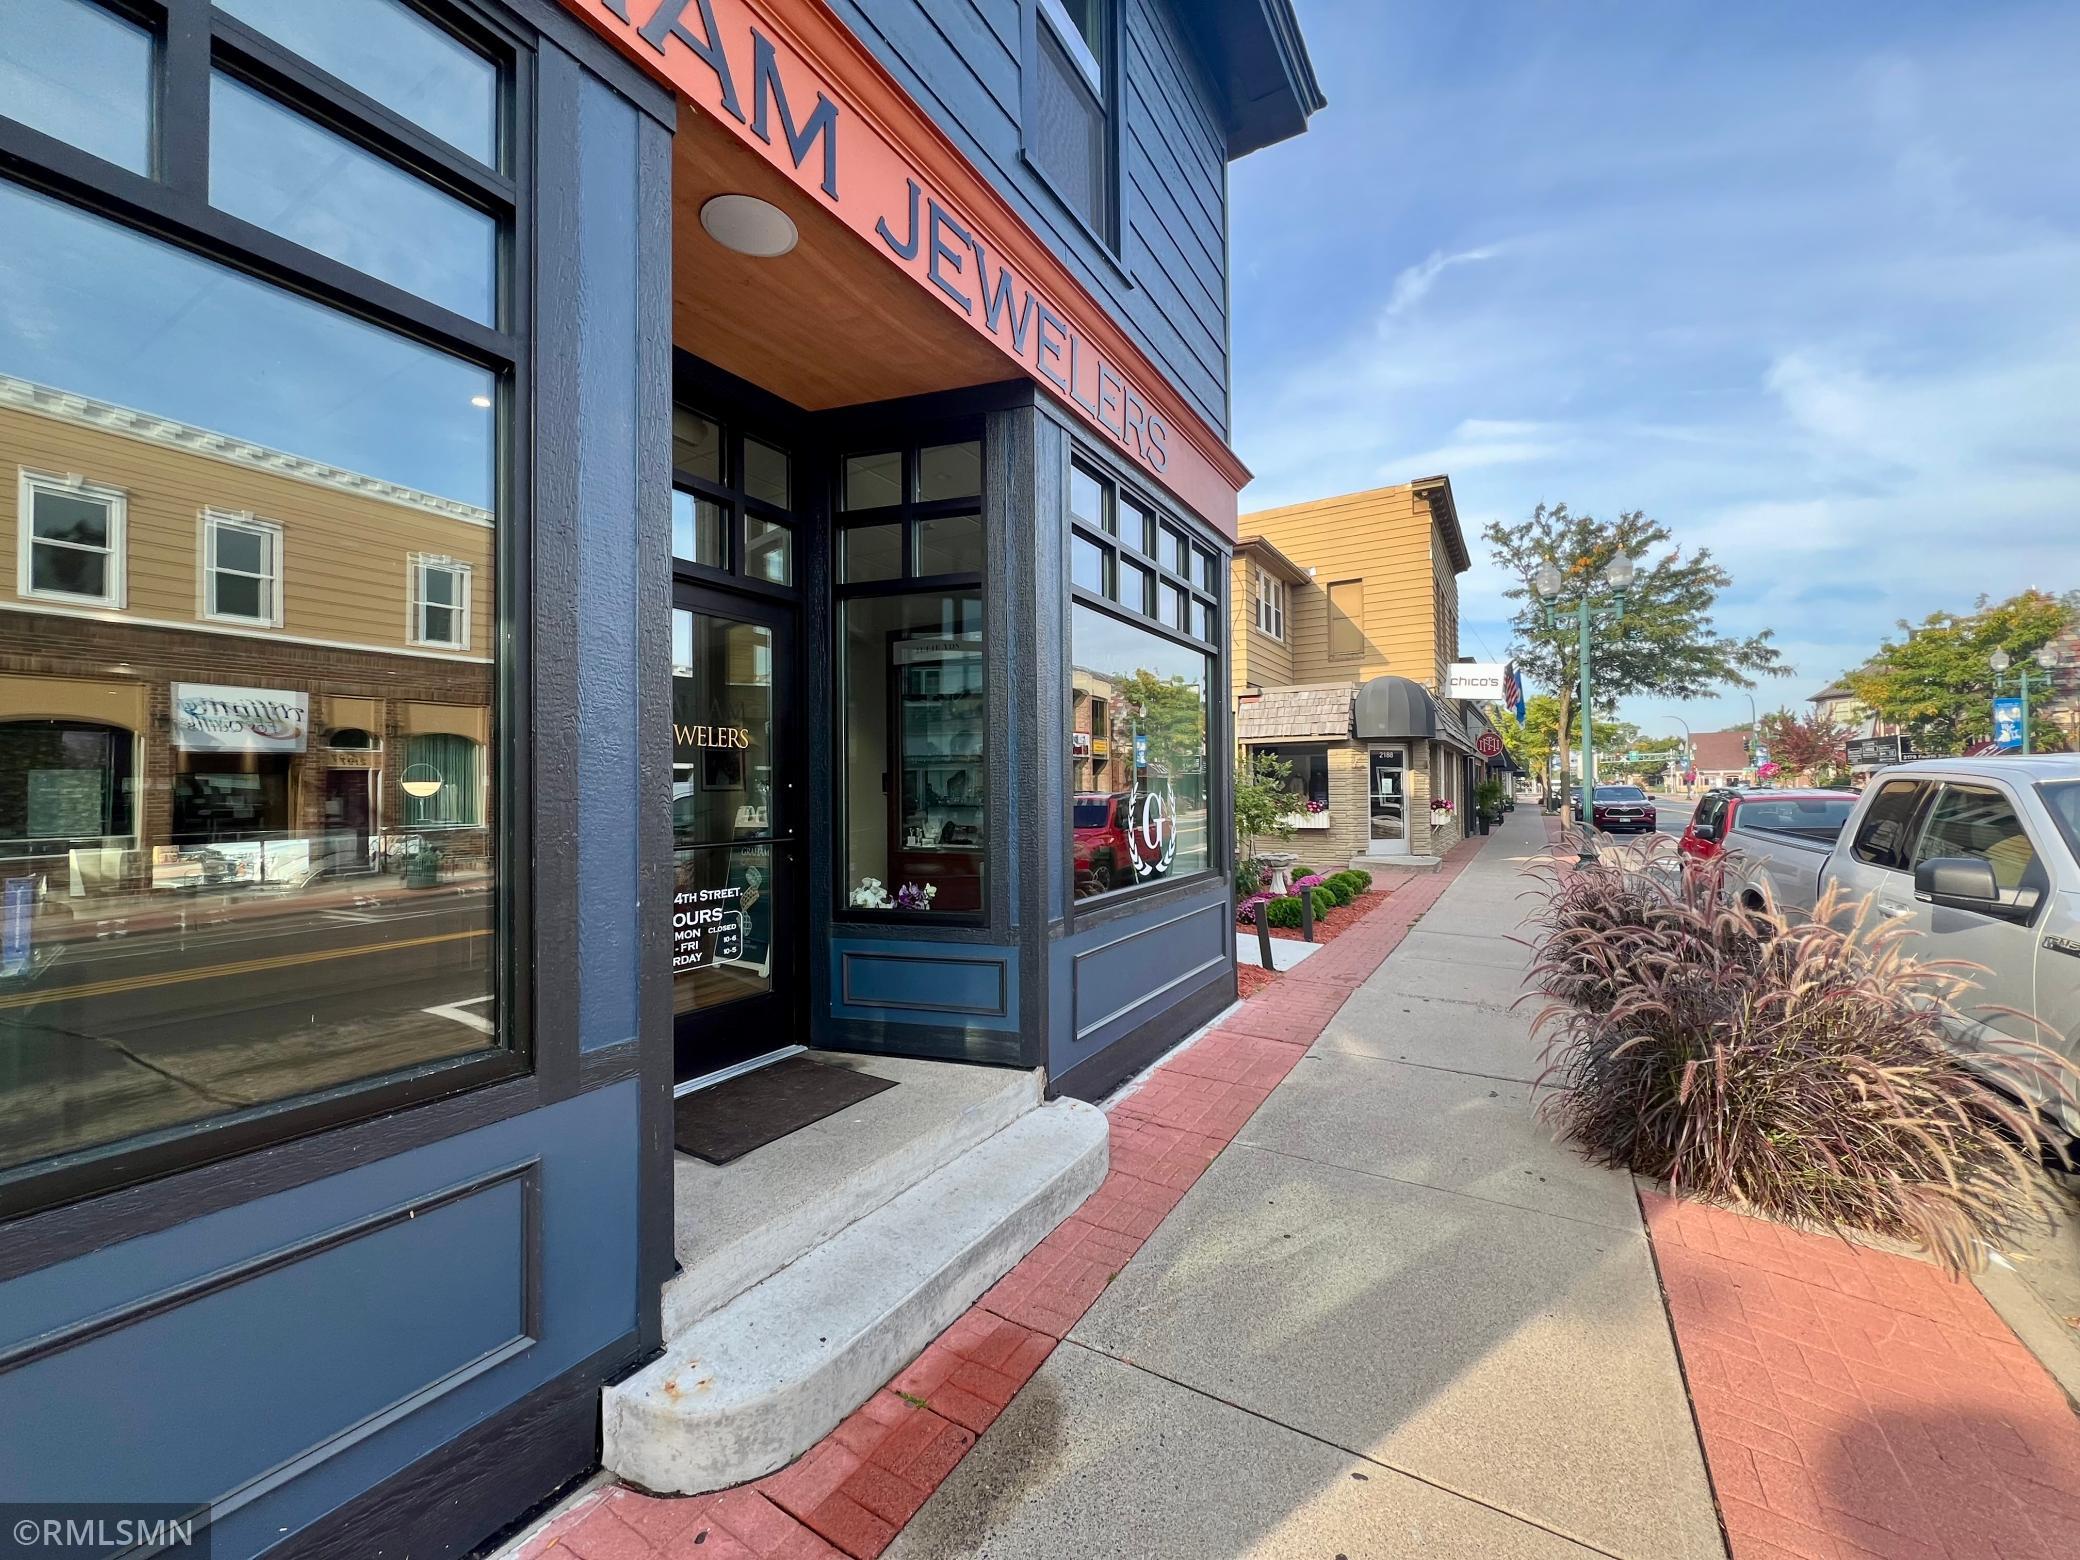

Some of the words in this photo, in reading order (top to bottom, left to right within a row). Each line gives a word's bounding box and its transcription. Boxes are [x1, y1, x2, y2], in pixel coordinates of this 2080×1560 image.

[874, 177, 1169, 475] JEWELERS
[1450, 676, 1499, 687] chico's
[673, 723, 750, 749] WELERS
[1142, 792, 1166, 850] G
[674, 892, 697, 904] 4TH
[673, 907, 723, 928] OURS
[675, 928, 701, 941] MON
[708, 924, 737, 934] CLOSED
[681, 941, 699, 953] FRI
[673, 952, 703, 967] RDAY
